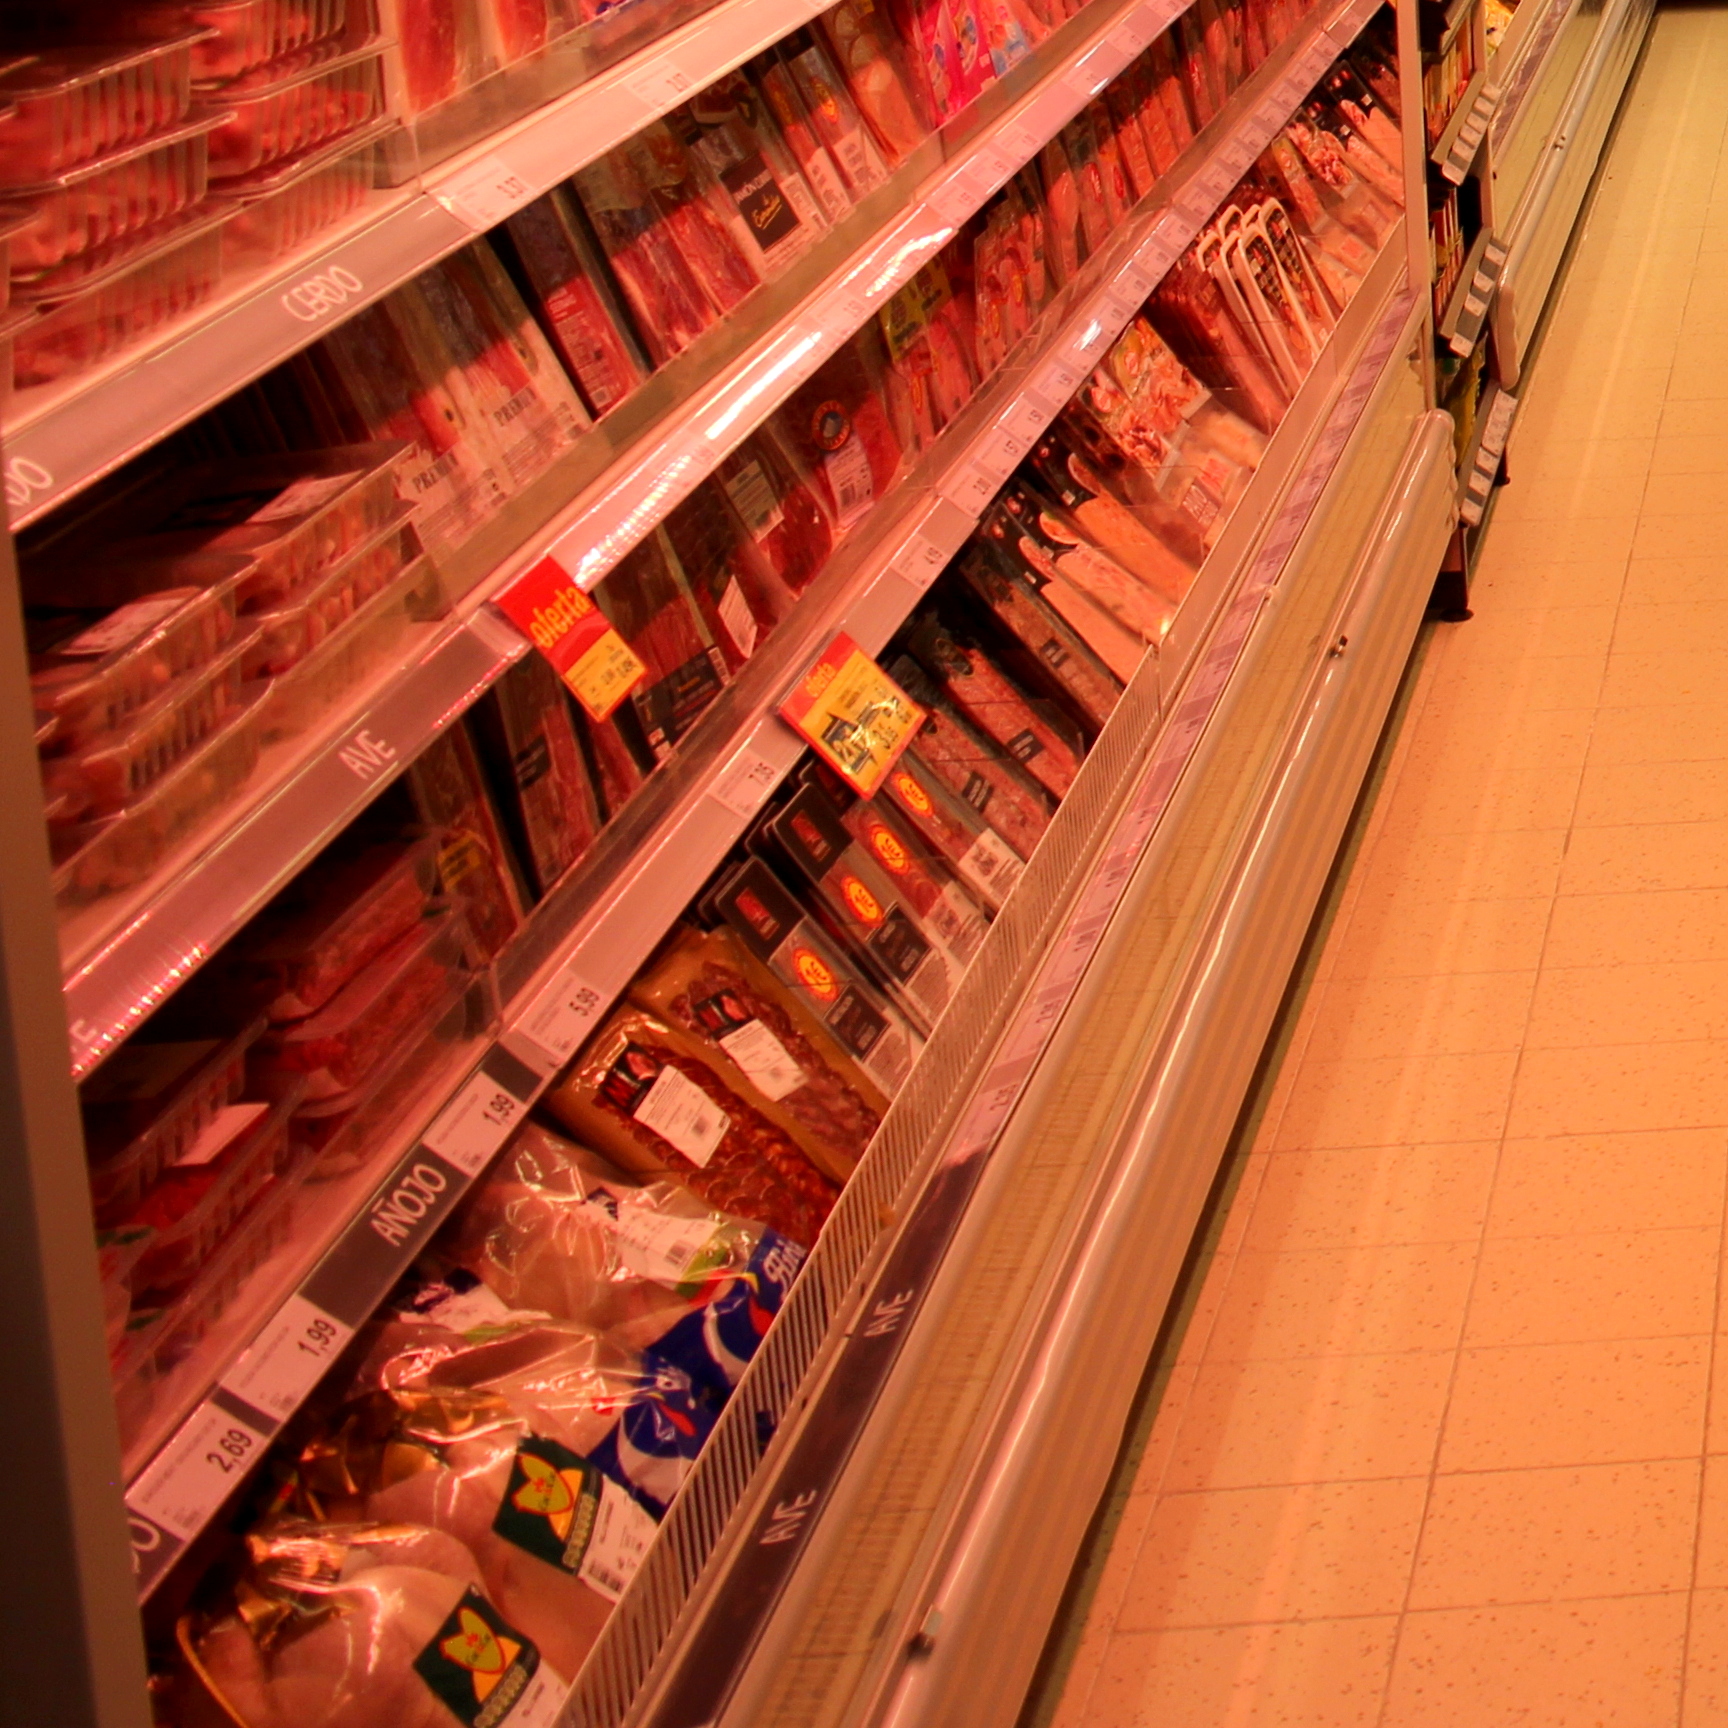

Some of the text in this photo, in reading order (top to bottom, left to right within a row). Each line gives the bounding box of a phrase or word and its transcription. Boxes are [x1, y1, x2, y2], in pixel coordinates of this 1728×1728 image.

[281, 266, 363, 321] CERDO
[529, 585, 591, 648] oferta
[339, 728, 398, 780] AVE
[481, 1091, 517, 1128] 1,99
[371, 1162, 448, 1248] AÑOJO
[297, 1318, 339, 1358] 1,99
[206, 1429, 254, 1474] 2,69
